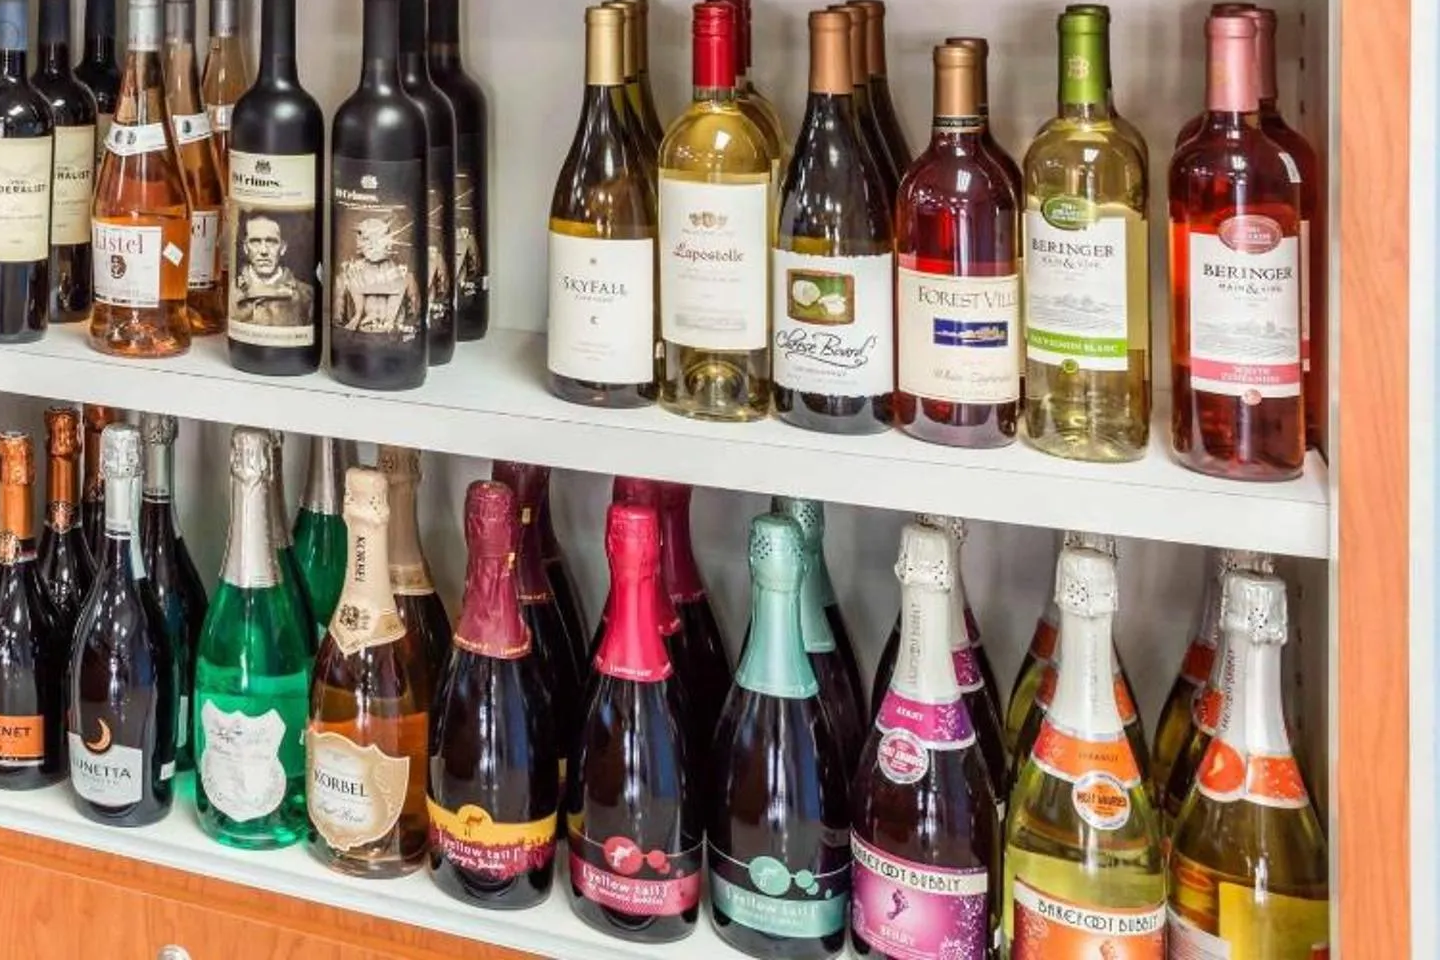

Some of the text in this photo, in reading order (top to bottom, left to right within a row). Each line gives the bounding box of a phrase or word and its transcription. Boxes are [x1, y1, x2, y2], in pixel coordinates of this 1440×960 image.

[673, 241, 744, 264] Lapostolle
[1032, 237, 1115, 258] BERINGER
[1203, 263, 1294, 281] BERINGER
[562, 275, 627, 296] SKYFALL
[1245, 284, 1259, 296] &
[918, 286, 980, 309] FOREST
[314, 768, 369, 798] KORBEL
[444, 838, 511, 861] yellow tail
[587, 872, 631, 892] yellow
[635, 882, 661, 896] tail
[1037, 898, 1158, 934] BAREFOOT BUBBLY
